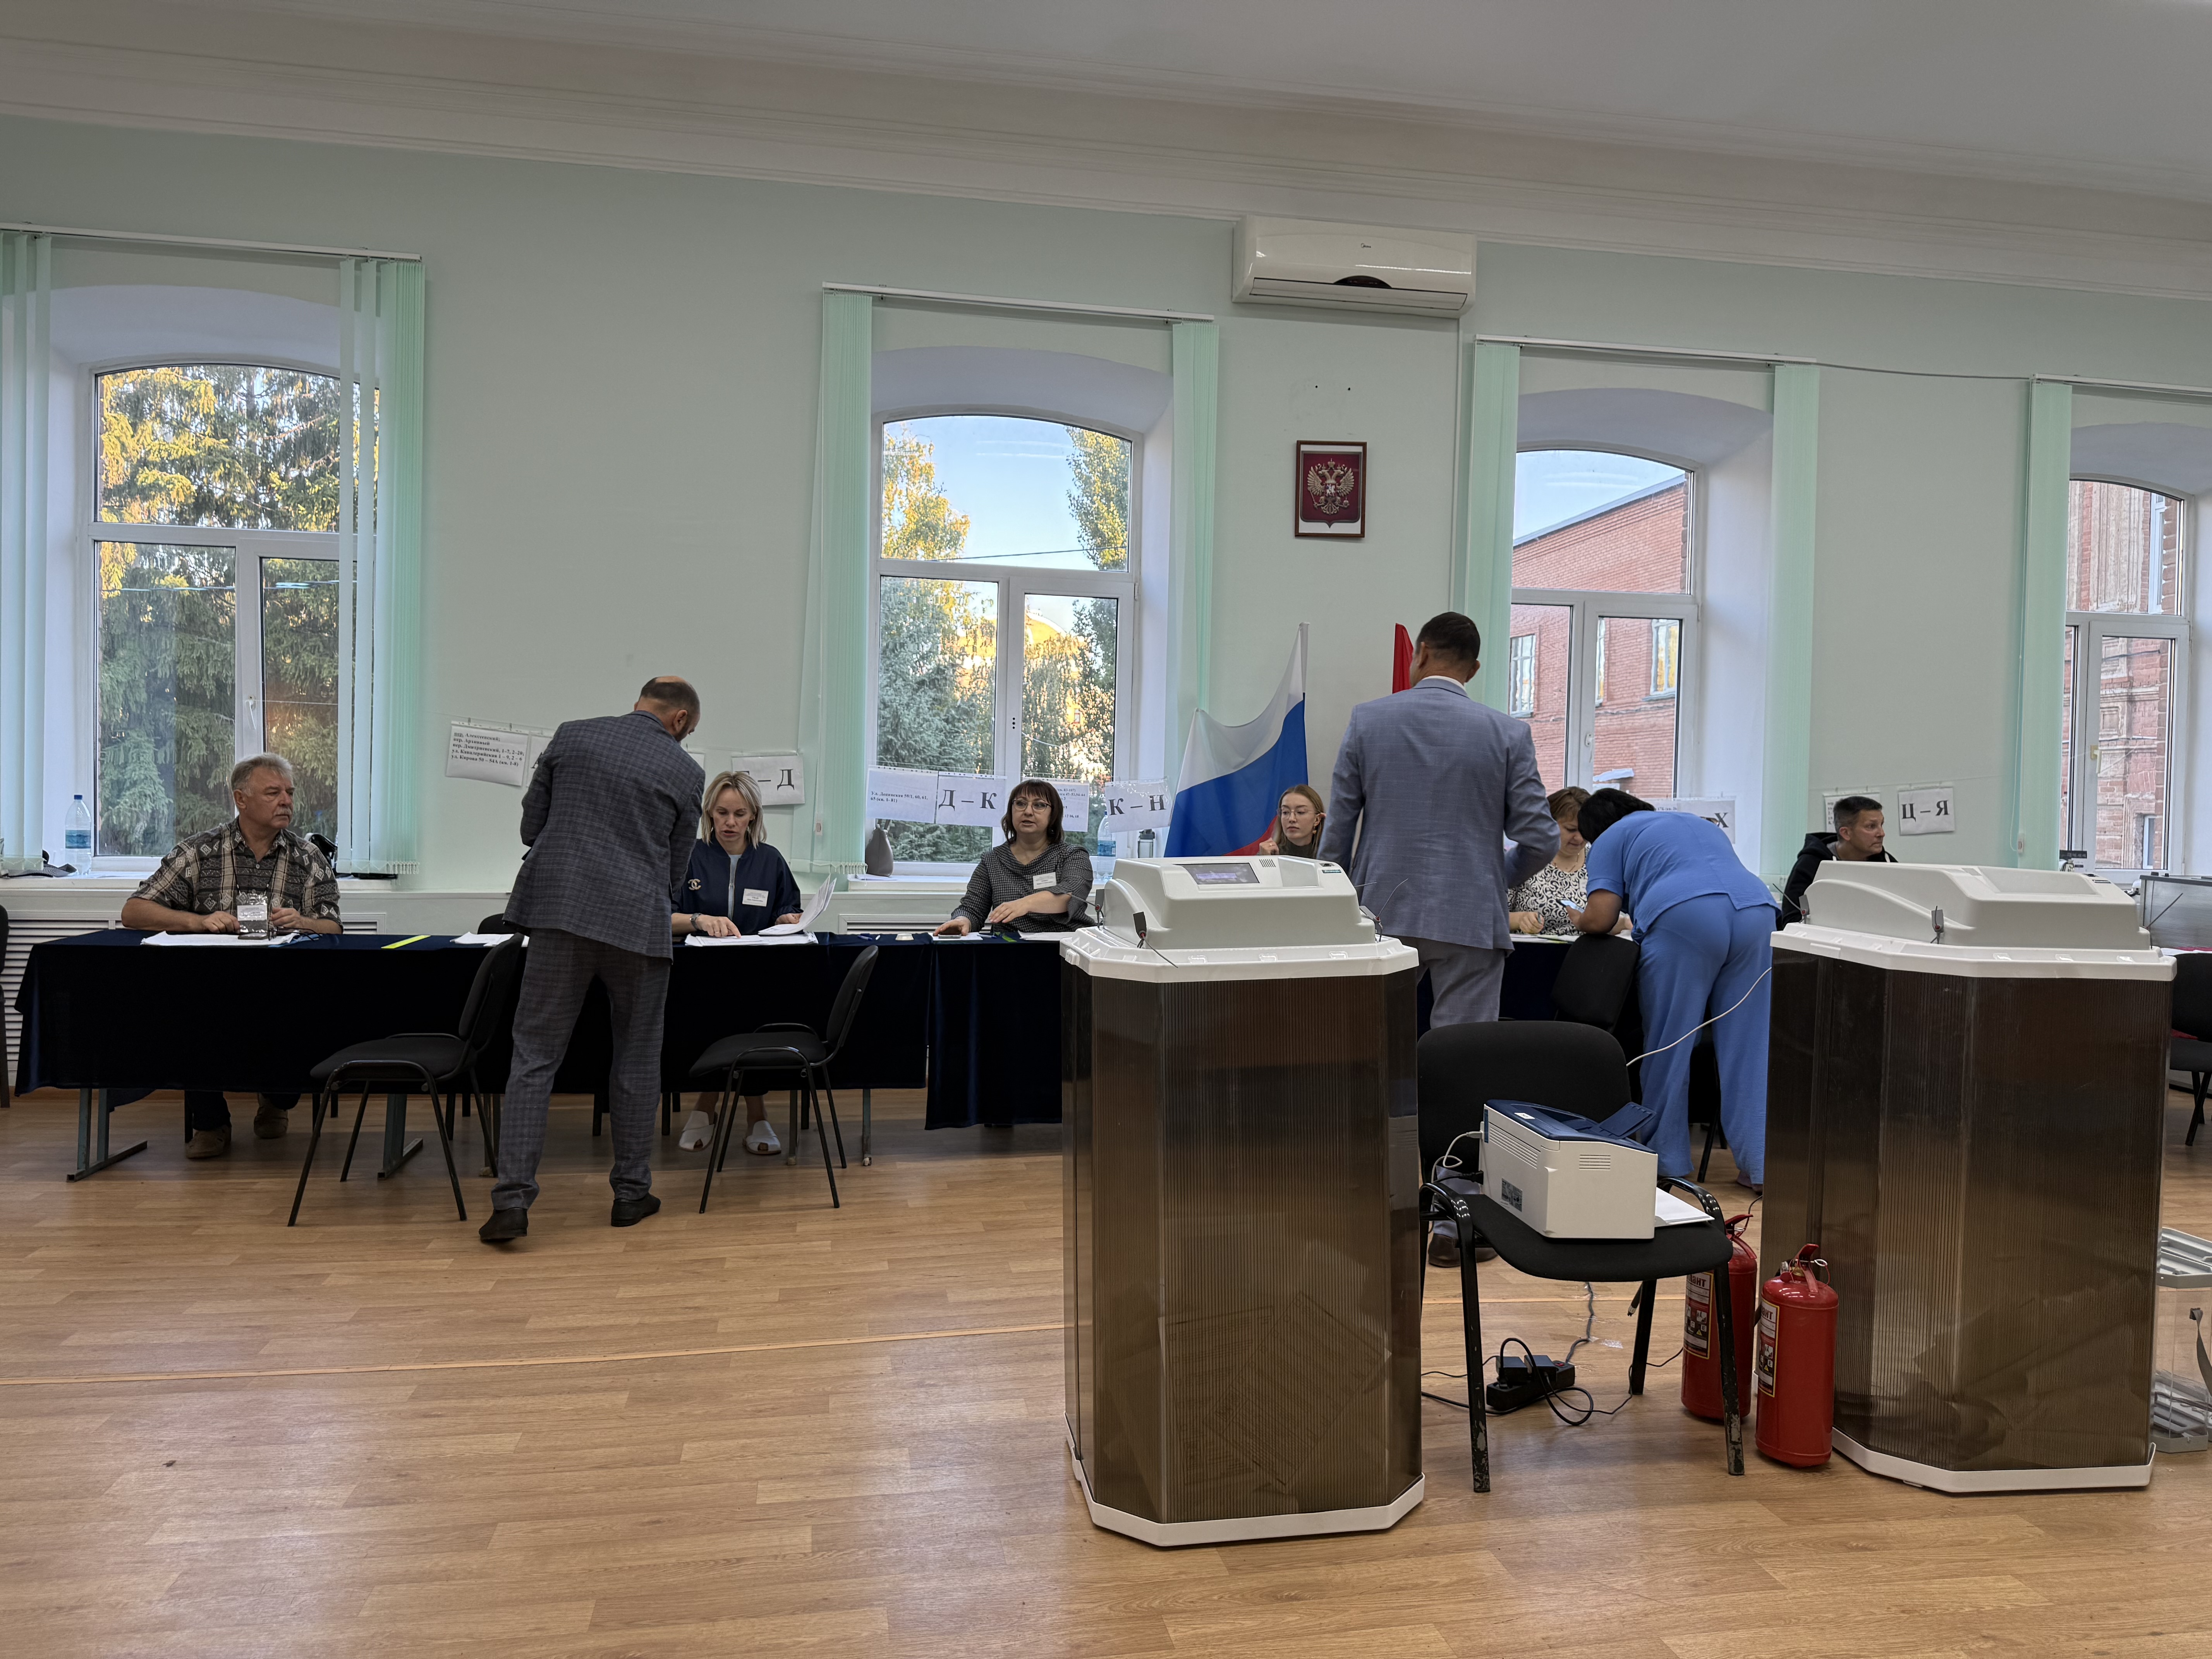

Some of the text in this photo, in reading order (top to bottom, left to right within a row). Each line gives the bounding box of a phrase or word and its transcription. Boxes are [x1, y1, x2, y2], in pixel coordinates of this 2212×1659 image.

[777, 769, 795, 791] Д
[938, 789, 957, 811] Д
[979, 792, 997, 809] К
[1108, 798, 1125, 816] К
[1147, 794, 1166, 811] Н
[1714, 812, 1729, 828] Х
[1902, 803, 1917, 823] Ц
[1935, 800, 1950, 816] Я
